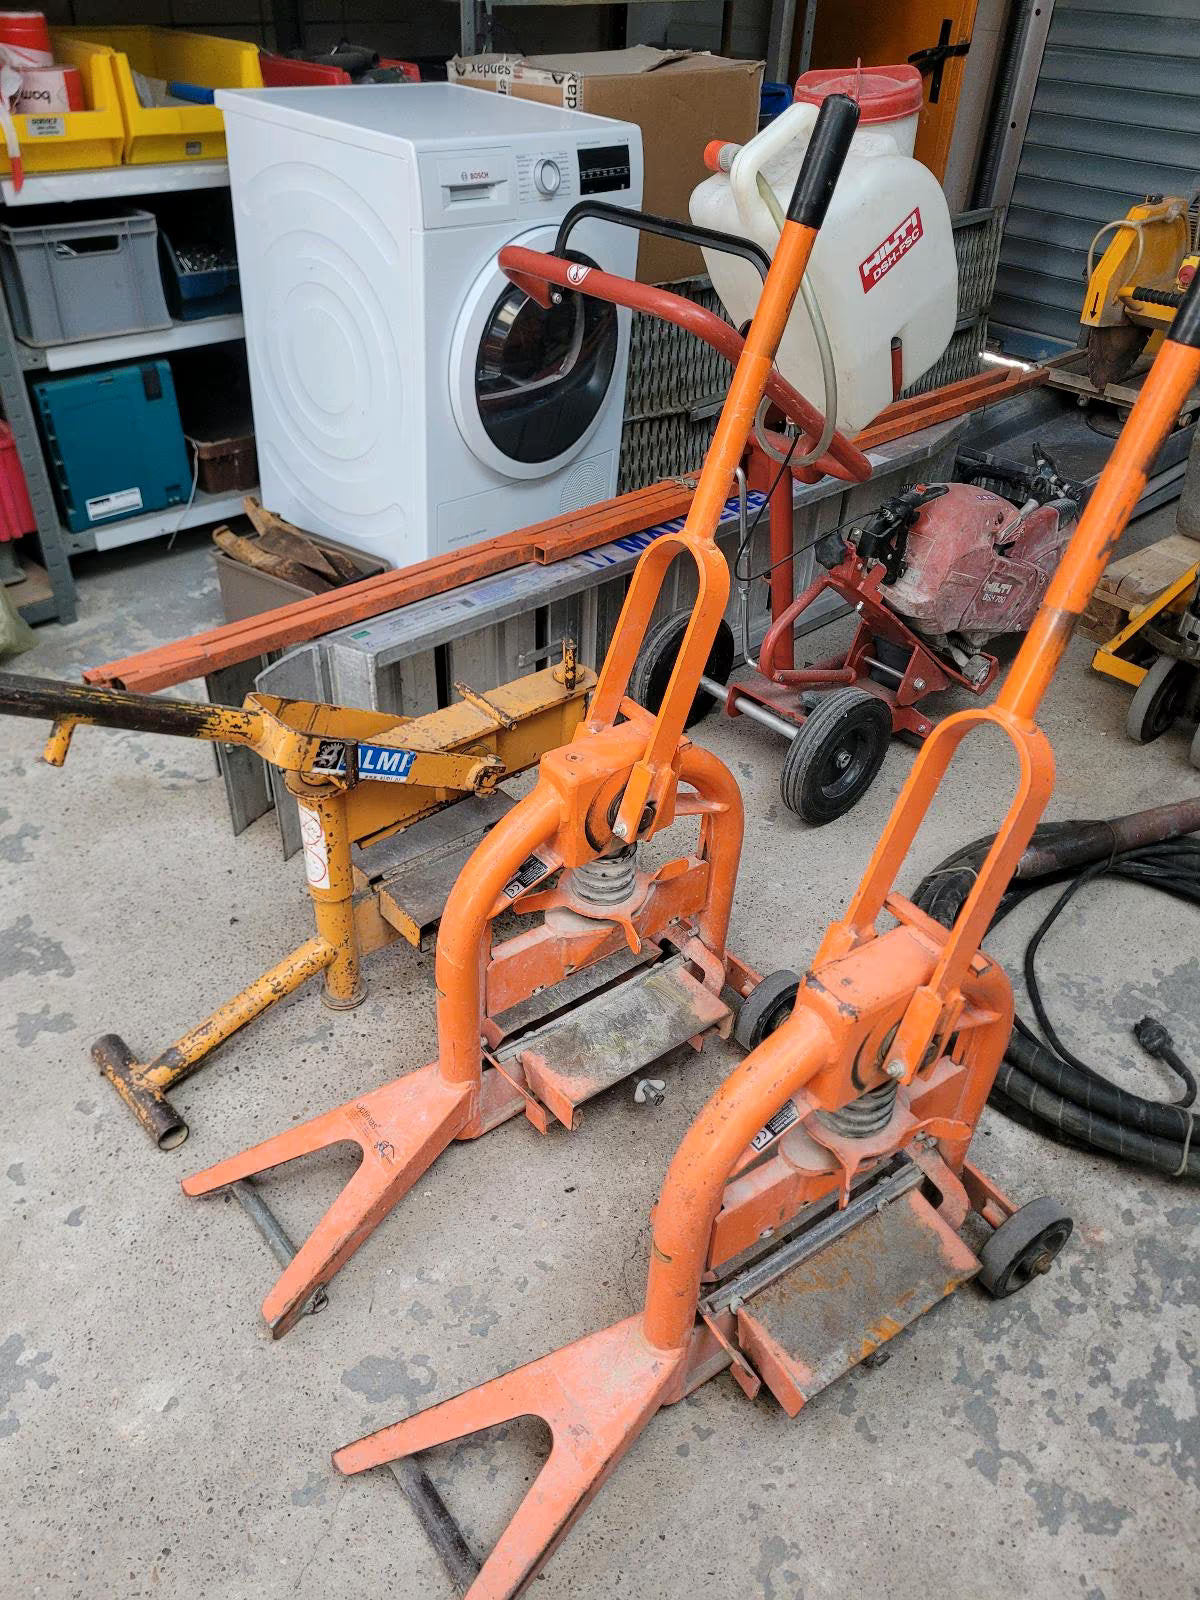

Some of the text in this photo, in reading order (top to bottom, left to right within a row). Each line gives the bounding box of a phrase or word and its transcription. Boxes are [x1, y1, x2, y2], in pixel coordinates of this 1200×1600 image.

[470, 171, 489, 180] BOSCH
[863, 212, 918, 277] HILTI
[873, 228, 920, 280] DSH-FSC
[983, 581, 1012, 595] HILTI
[356, 747, 412, 773] LMI
